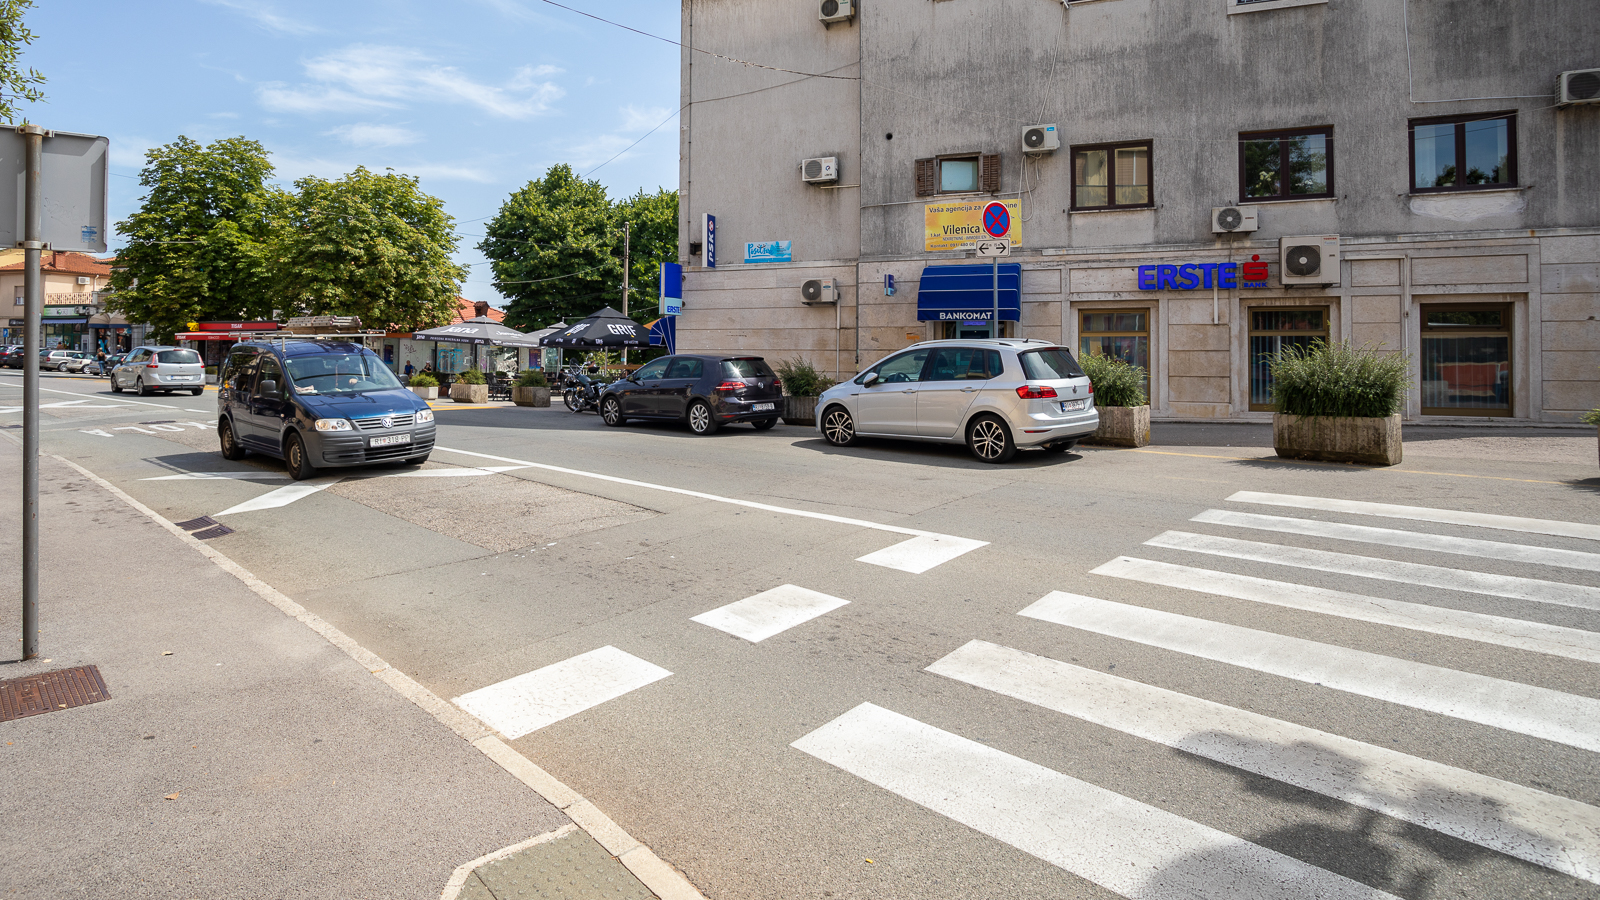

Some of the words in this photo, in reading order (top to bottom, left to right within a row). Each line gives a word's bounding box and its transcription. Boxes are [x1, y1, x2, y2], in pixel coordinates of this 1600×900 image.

[945, 204, 973, 213] agencija
[942, 224, 980, 235] Vilenica
[1138, 262, 1237, 290] ERSTE
[666, 305, 680, 314] ERSTE
[939, 311, 992, 320] BANKOMAT
[606, 323, 637, 336] GRIF
